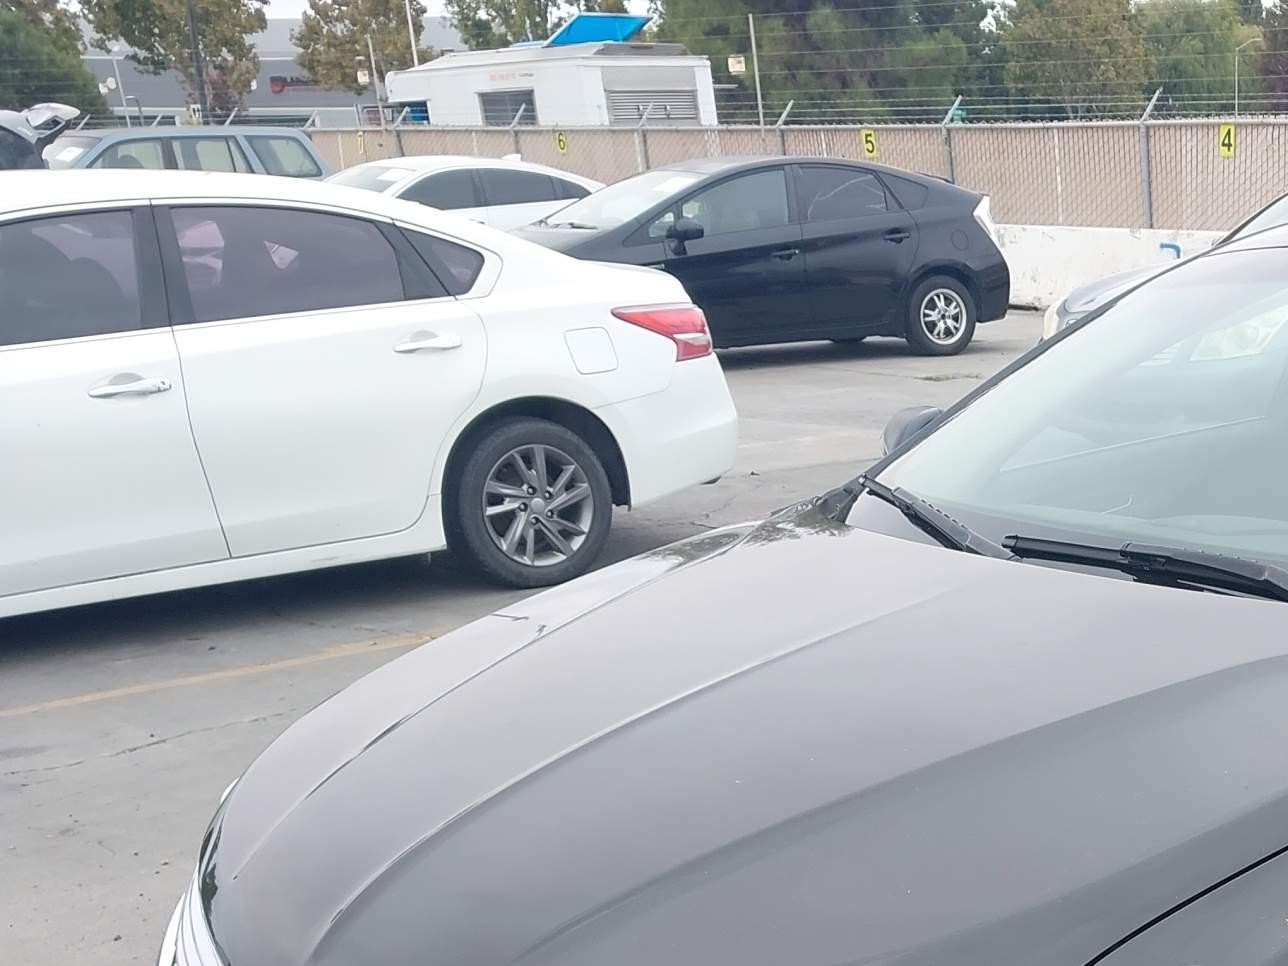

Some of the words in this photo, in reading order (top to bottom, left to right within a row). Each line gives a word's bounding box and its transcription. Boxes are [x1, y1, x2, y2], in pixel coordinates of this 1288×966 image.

[558, 131, 566, 151] 6
[864, 132, 875, 154] 5
[1221, 127, 1233, 153] 4
